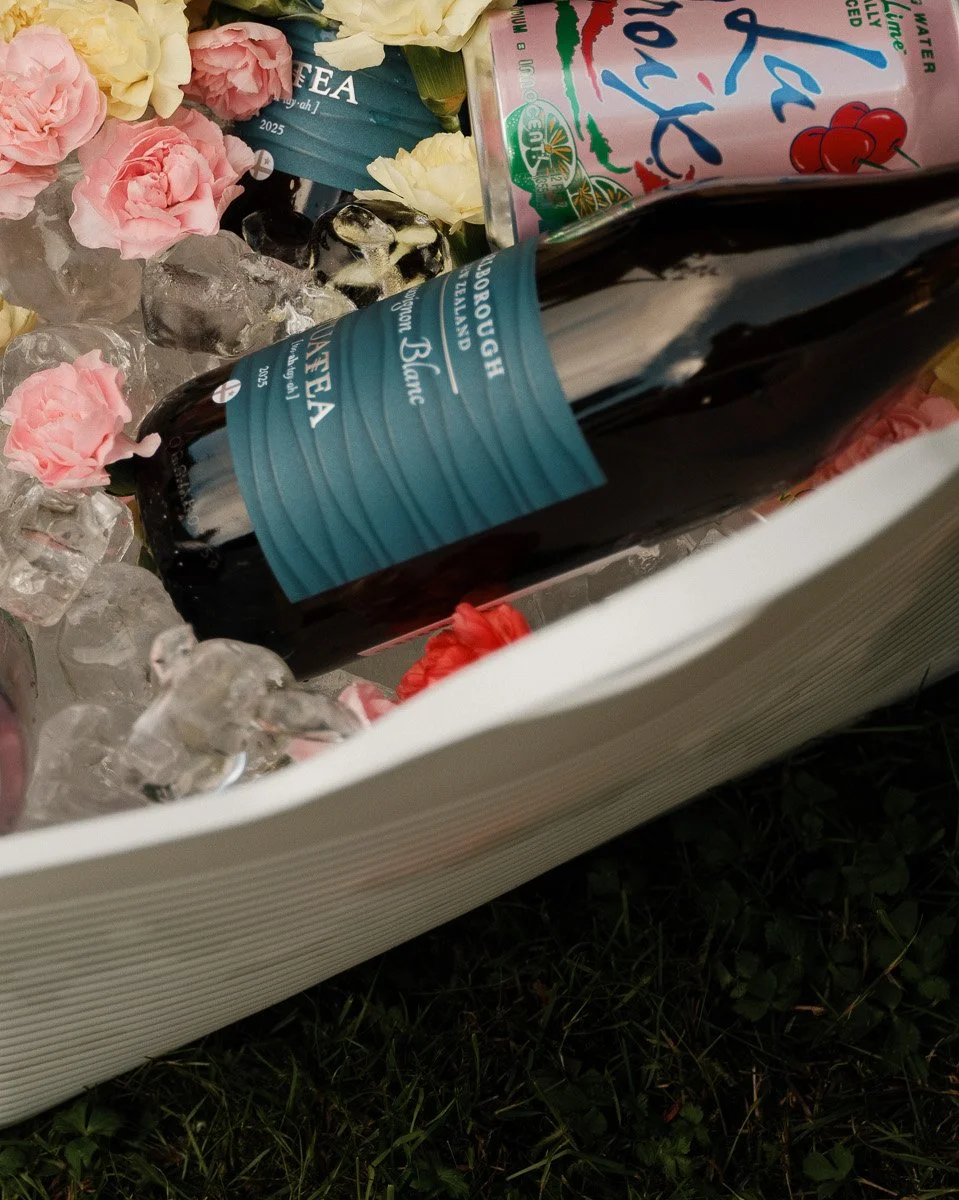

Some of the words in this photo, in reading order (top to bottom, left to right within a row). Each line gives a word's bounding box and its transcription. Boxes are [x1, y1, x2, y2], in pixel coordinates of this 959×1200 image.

[723, 7, 887, 124] La
[913, 13, 936, 73] WATER
[292, 60, 359, 105] TEA
[259, 119, 285, 135] 2025
[454, 280, 472, 351] ZEALAND
[257, 365, 270, 388] 2025
[304, 319, 336, 429] UATEA
[399, 336, 441, 406] Blanc
